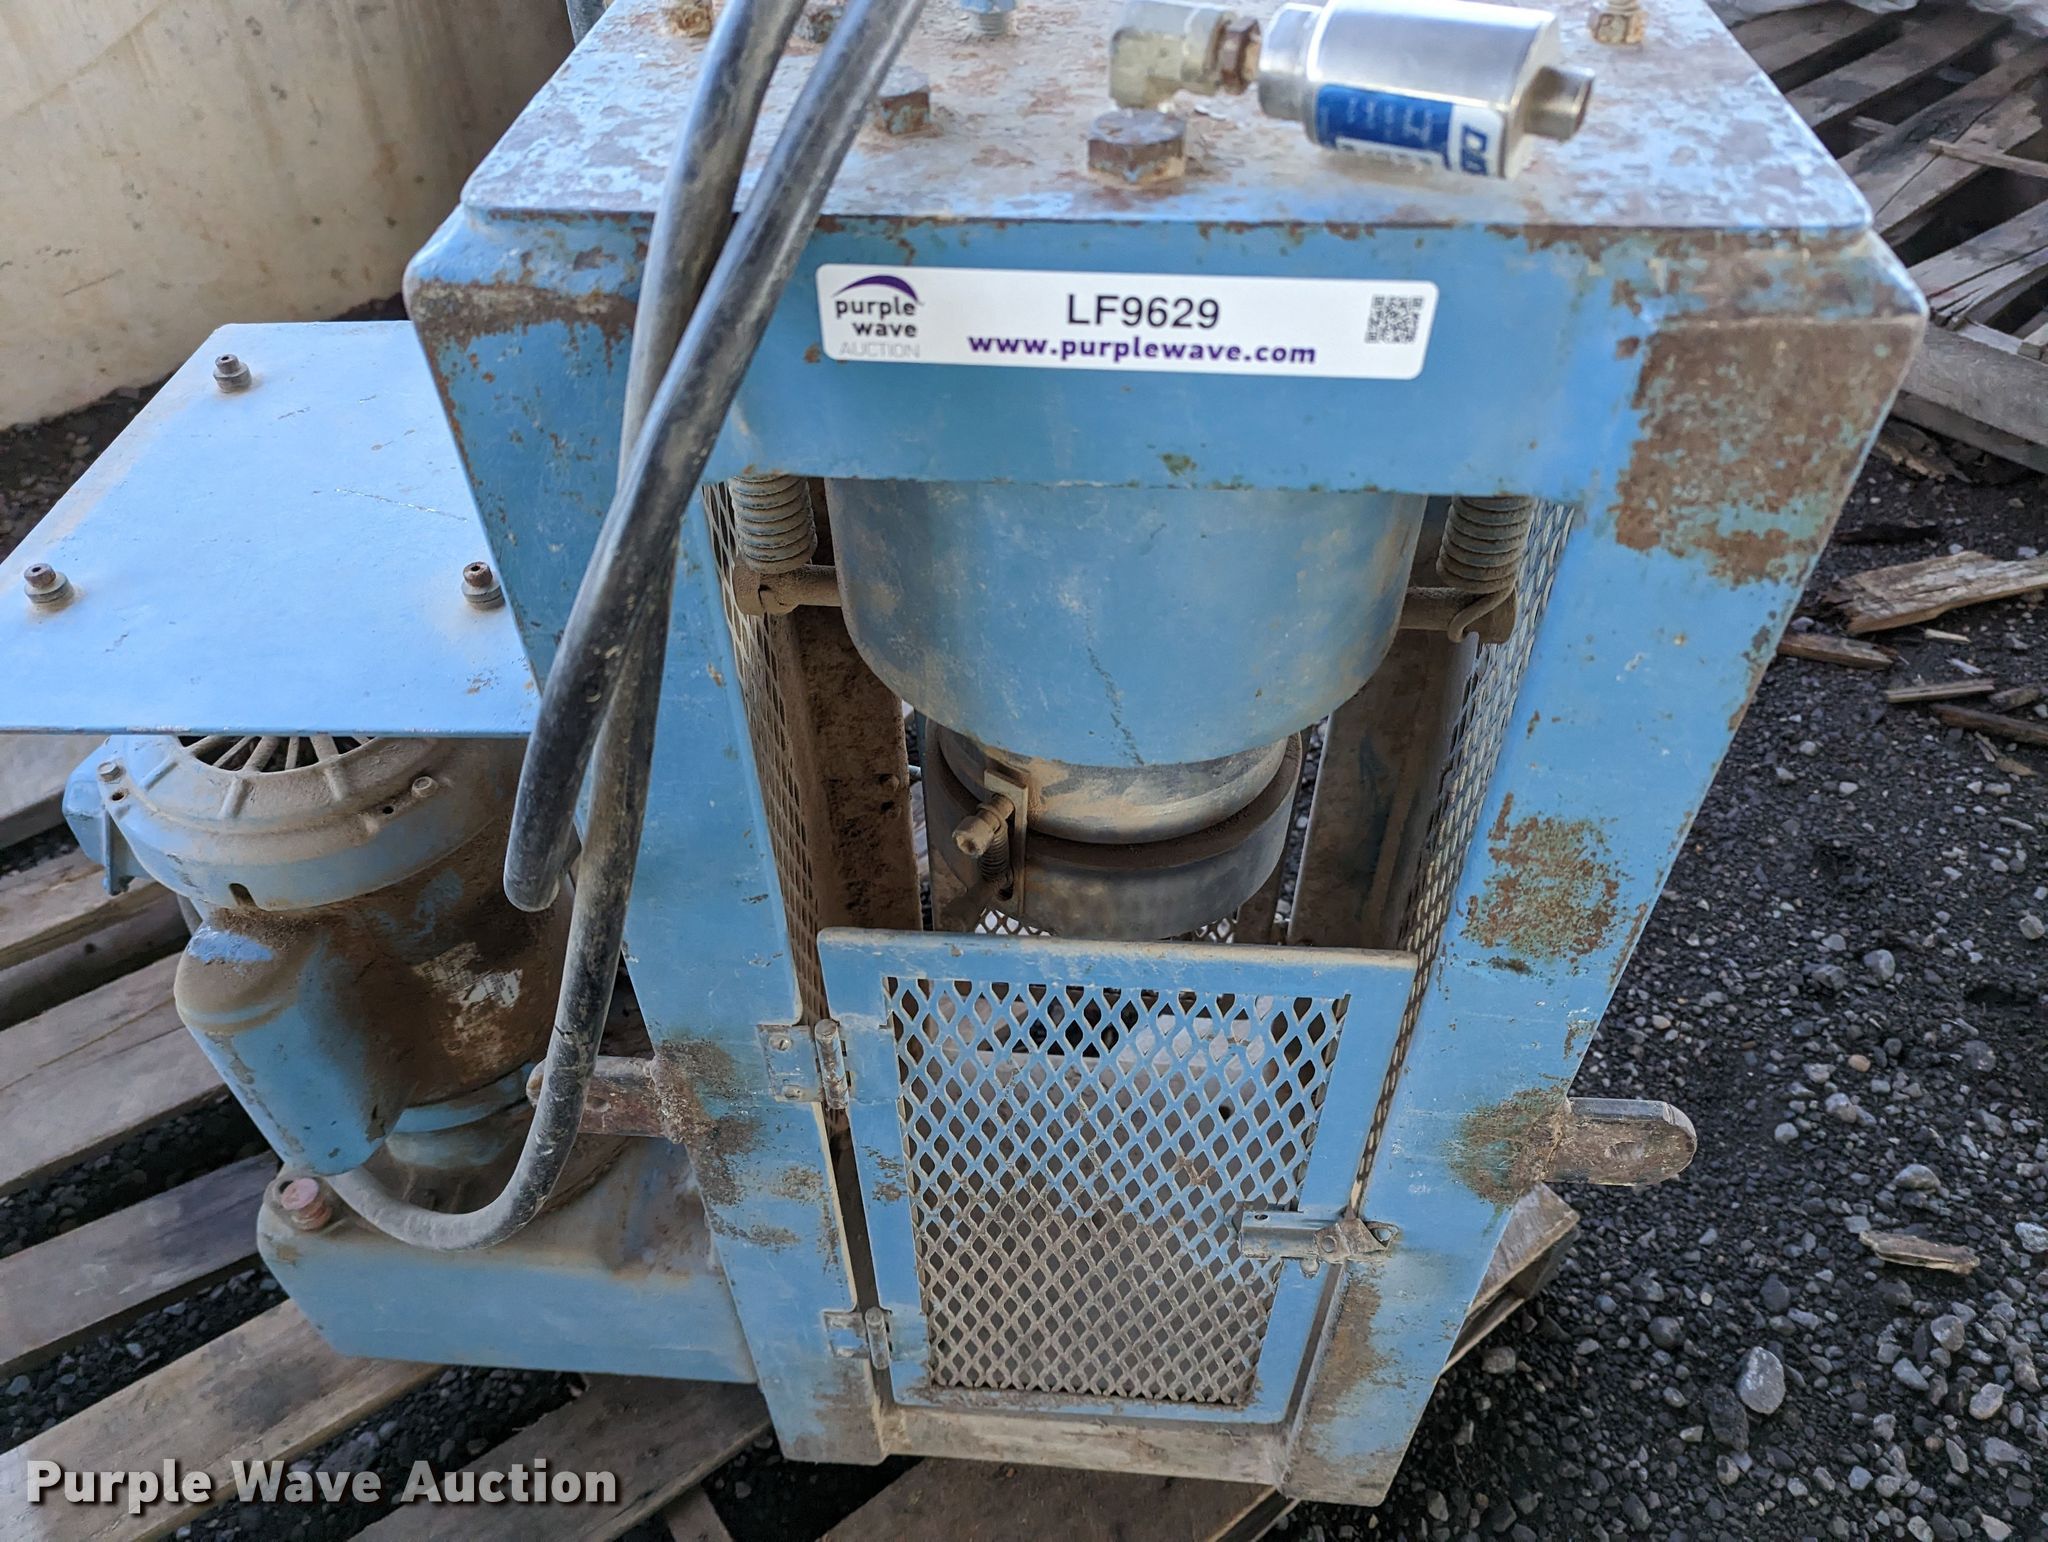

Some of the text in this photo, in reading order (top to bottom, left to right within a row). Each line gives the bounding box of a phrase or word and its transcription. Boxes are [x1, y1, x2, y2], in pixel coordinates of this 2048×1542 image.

[836, 296, 916, 320] purple
[1067, 294, 1221, 329] LF9629
[851, 322, 917, 338] wave
[839, 342, 921, 358] AUCTION
[968, 336, 1317, 364] www.purplewave.com
